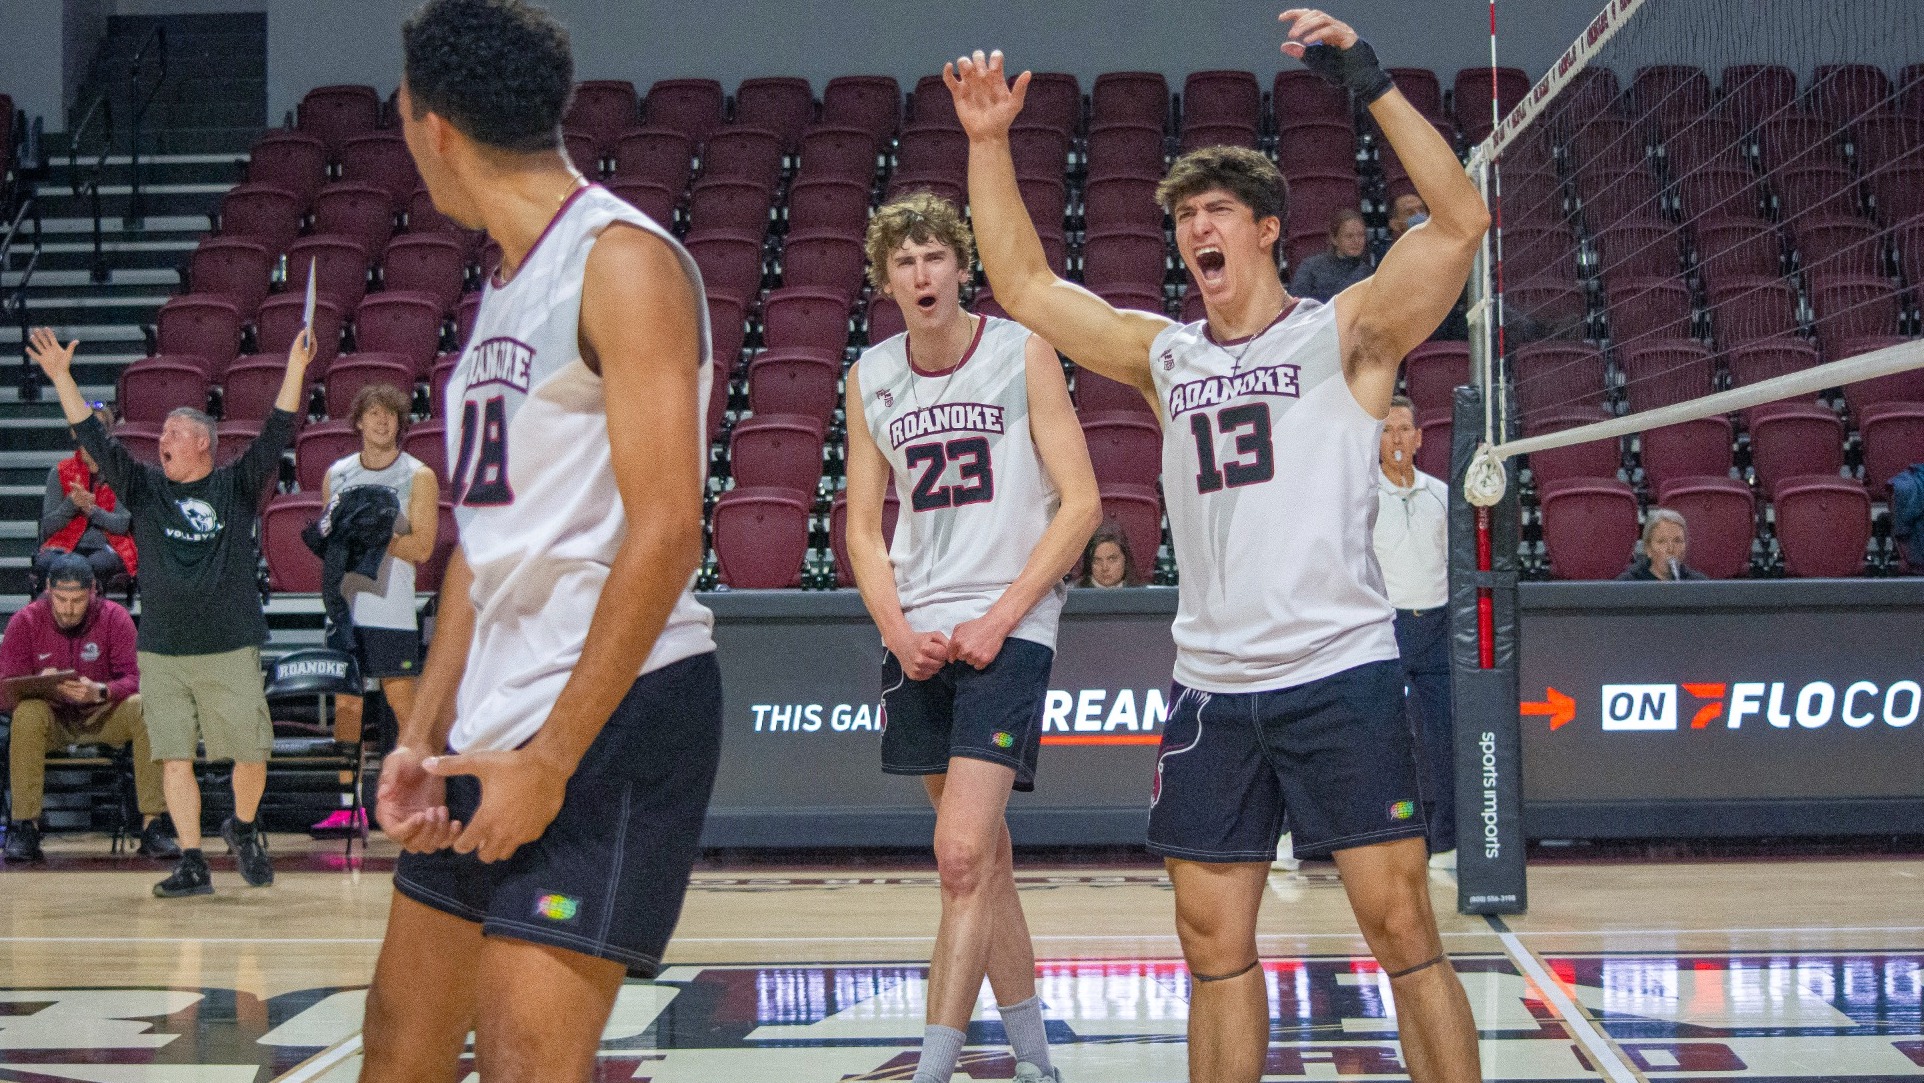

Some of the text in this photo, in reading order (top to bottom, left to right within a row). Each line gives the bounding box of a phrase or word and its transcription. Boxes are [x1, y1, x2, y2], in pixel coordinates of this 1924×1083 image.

[1169, 364, 1301, 421] ROANOKE
[452, 395, 515, 507] 18
[890, 402, 1005, 451] ROANOKE
[1189, 401, 1275, 494] 13
[905, 436, 995, 513] 23
[277, 661, 348, 680] ROANOKE
[751, 704, 823, 731] THIS
[1609, 680, 1922, 729] ON FLOCO
[1479, 731, 1500, 858] sports imports
